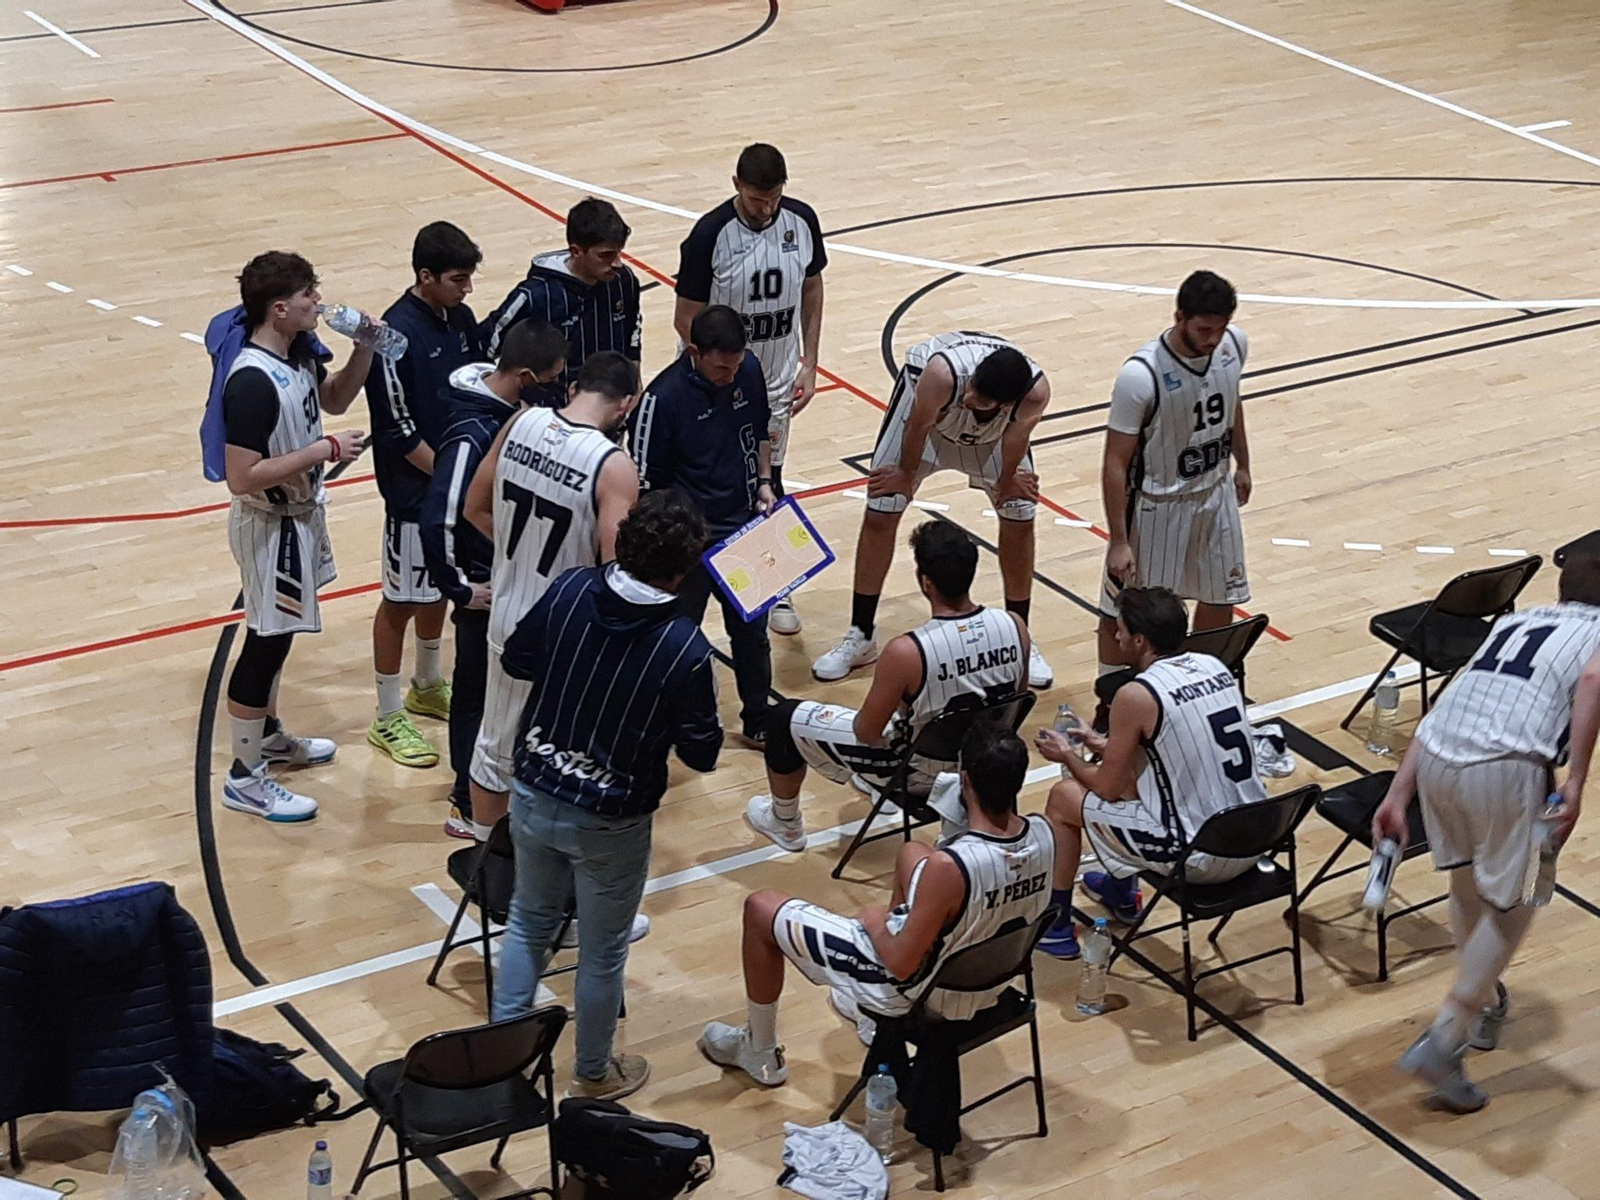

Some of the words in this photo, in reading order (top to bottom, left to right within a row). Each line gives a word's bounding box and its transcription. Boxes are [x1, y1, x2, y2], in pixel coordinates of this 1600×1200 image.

[749, 268, 783, 302] 10
[302, 387, 320, 436] 50
[1193, 392, 1225, 432] 19
[503, 439, 589, 493] RODRÍGUEZ
[502, 478, 573, 578] 77
[937, 663, 954, 682] J.
[955, 645, 1018, 677] BLANCO
[1469, 620, 1560, 681] 11
[1206, 705, 1253, 784] 5
[1002, 871, 1048, 905] PÉREZ
